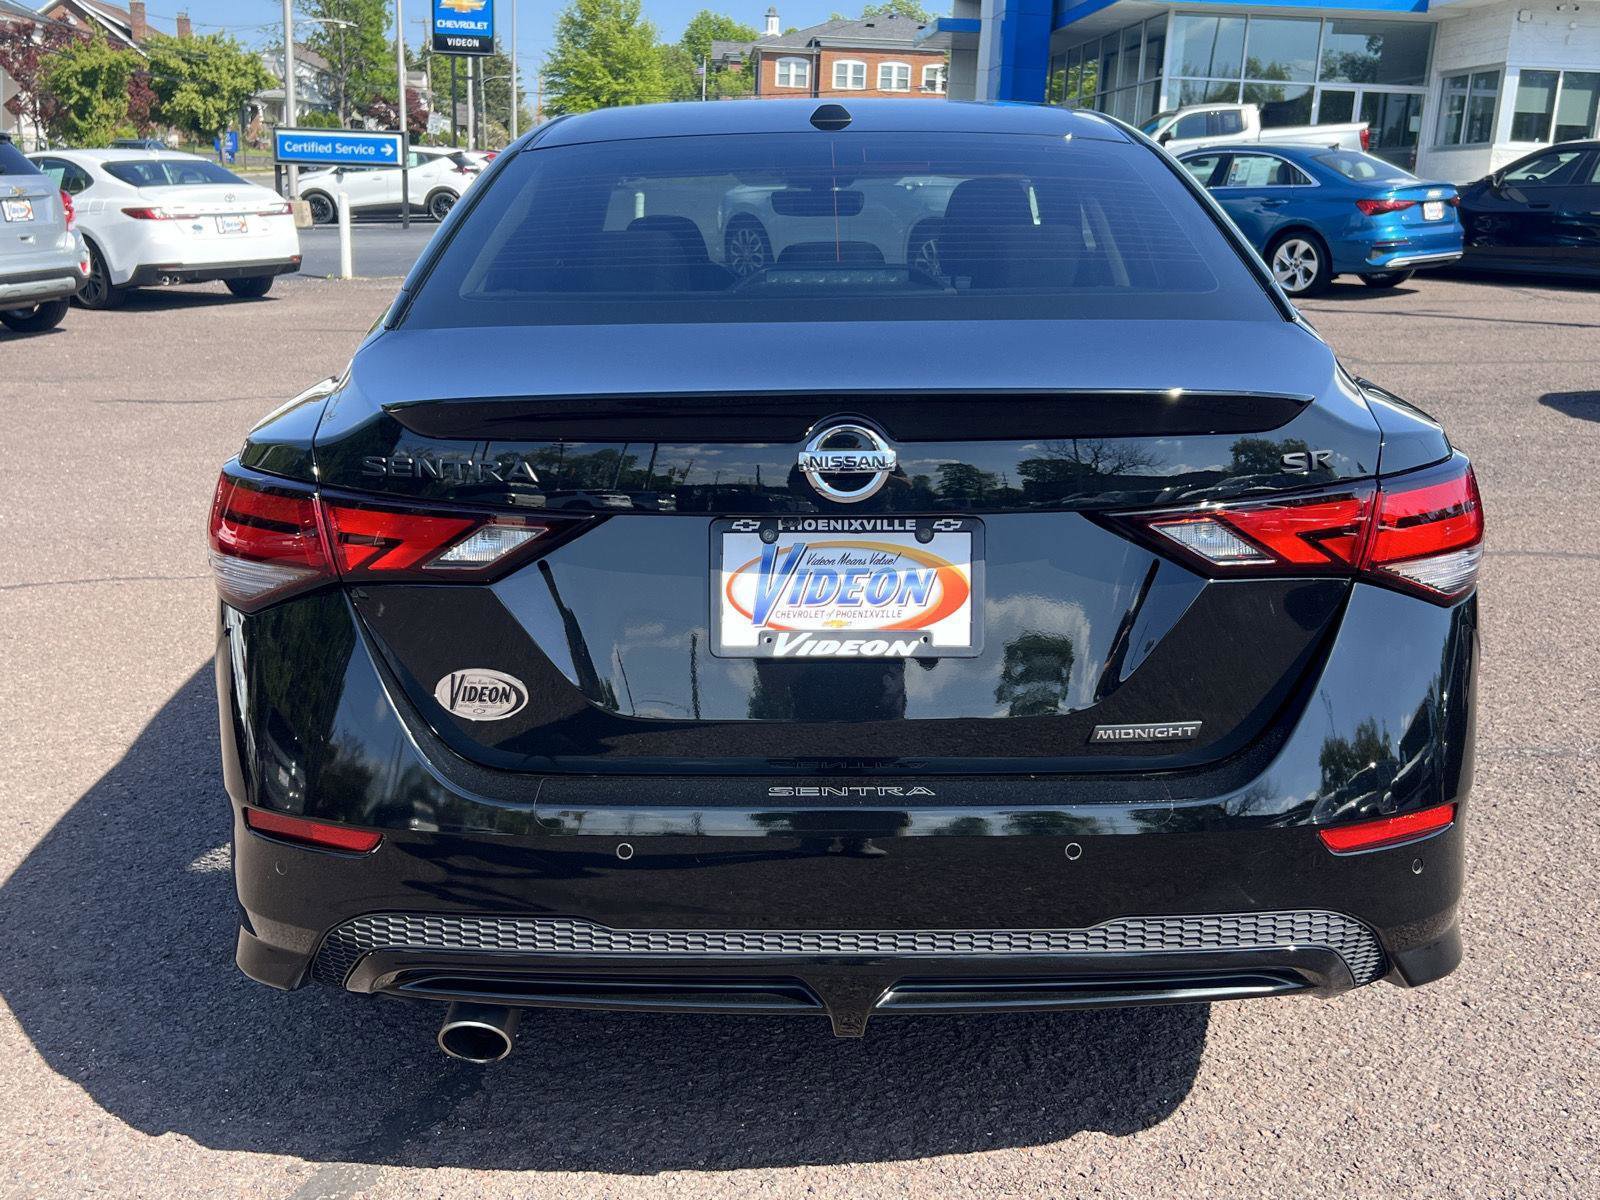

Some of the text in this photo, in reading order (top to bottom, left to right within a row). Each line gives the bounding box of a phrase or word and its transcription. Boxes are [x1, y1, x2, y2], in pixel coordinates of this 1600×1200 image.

[436, 19, 489, 30] CHEVROLET
[446, 37, 480, 47] VIDEON
[284, 141, 375, 155] Certified Service
[809, 455, 886, 468] NISSAN
[1280, 449, 1336, 475] SR
[361, 455, 540, 483] SENTRA
[806, 552, 902, 567] Videon Means Value!
[751, 543, 938, 628] VIDEON
[775, 610, 826, 619] CHEVROLET
[835, 609, 903, 619] PHOENIXVILLE
[773, 632, 920, 656] VIDEON
[449, 673, 514, 711] VIDEON
[1096, 726, 1196, 740] MIDNIGHT
[768, 786, 936, 797] SENTRA
